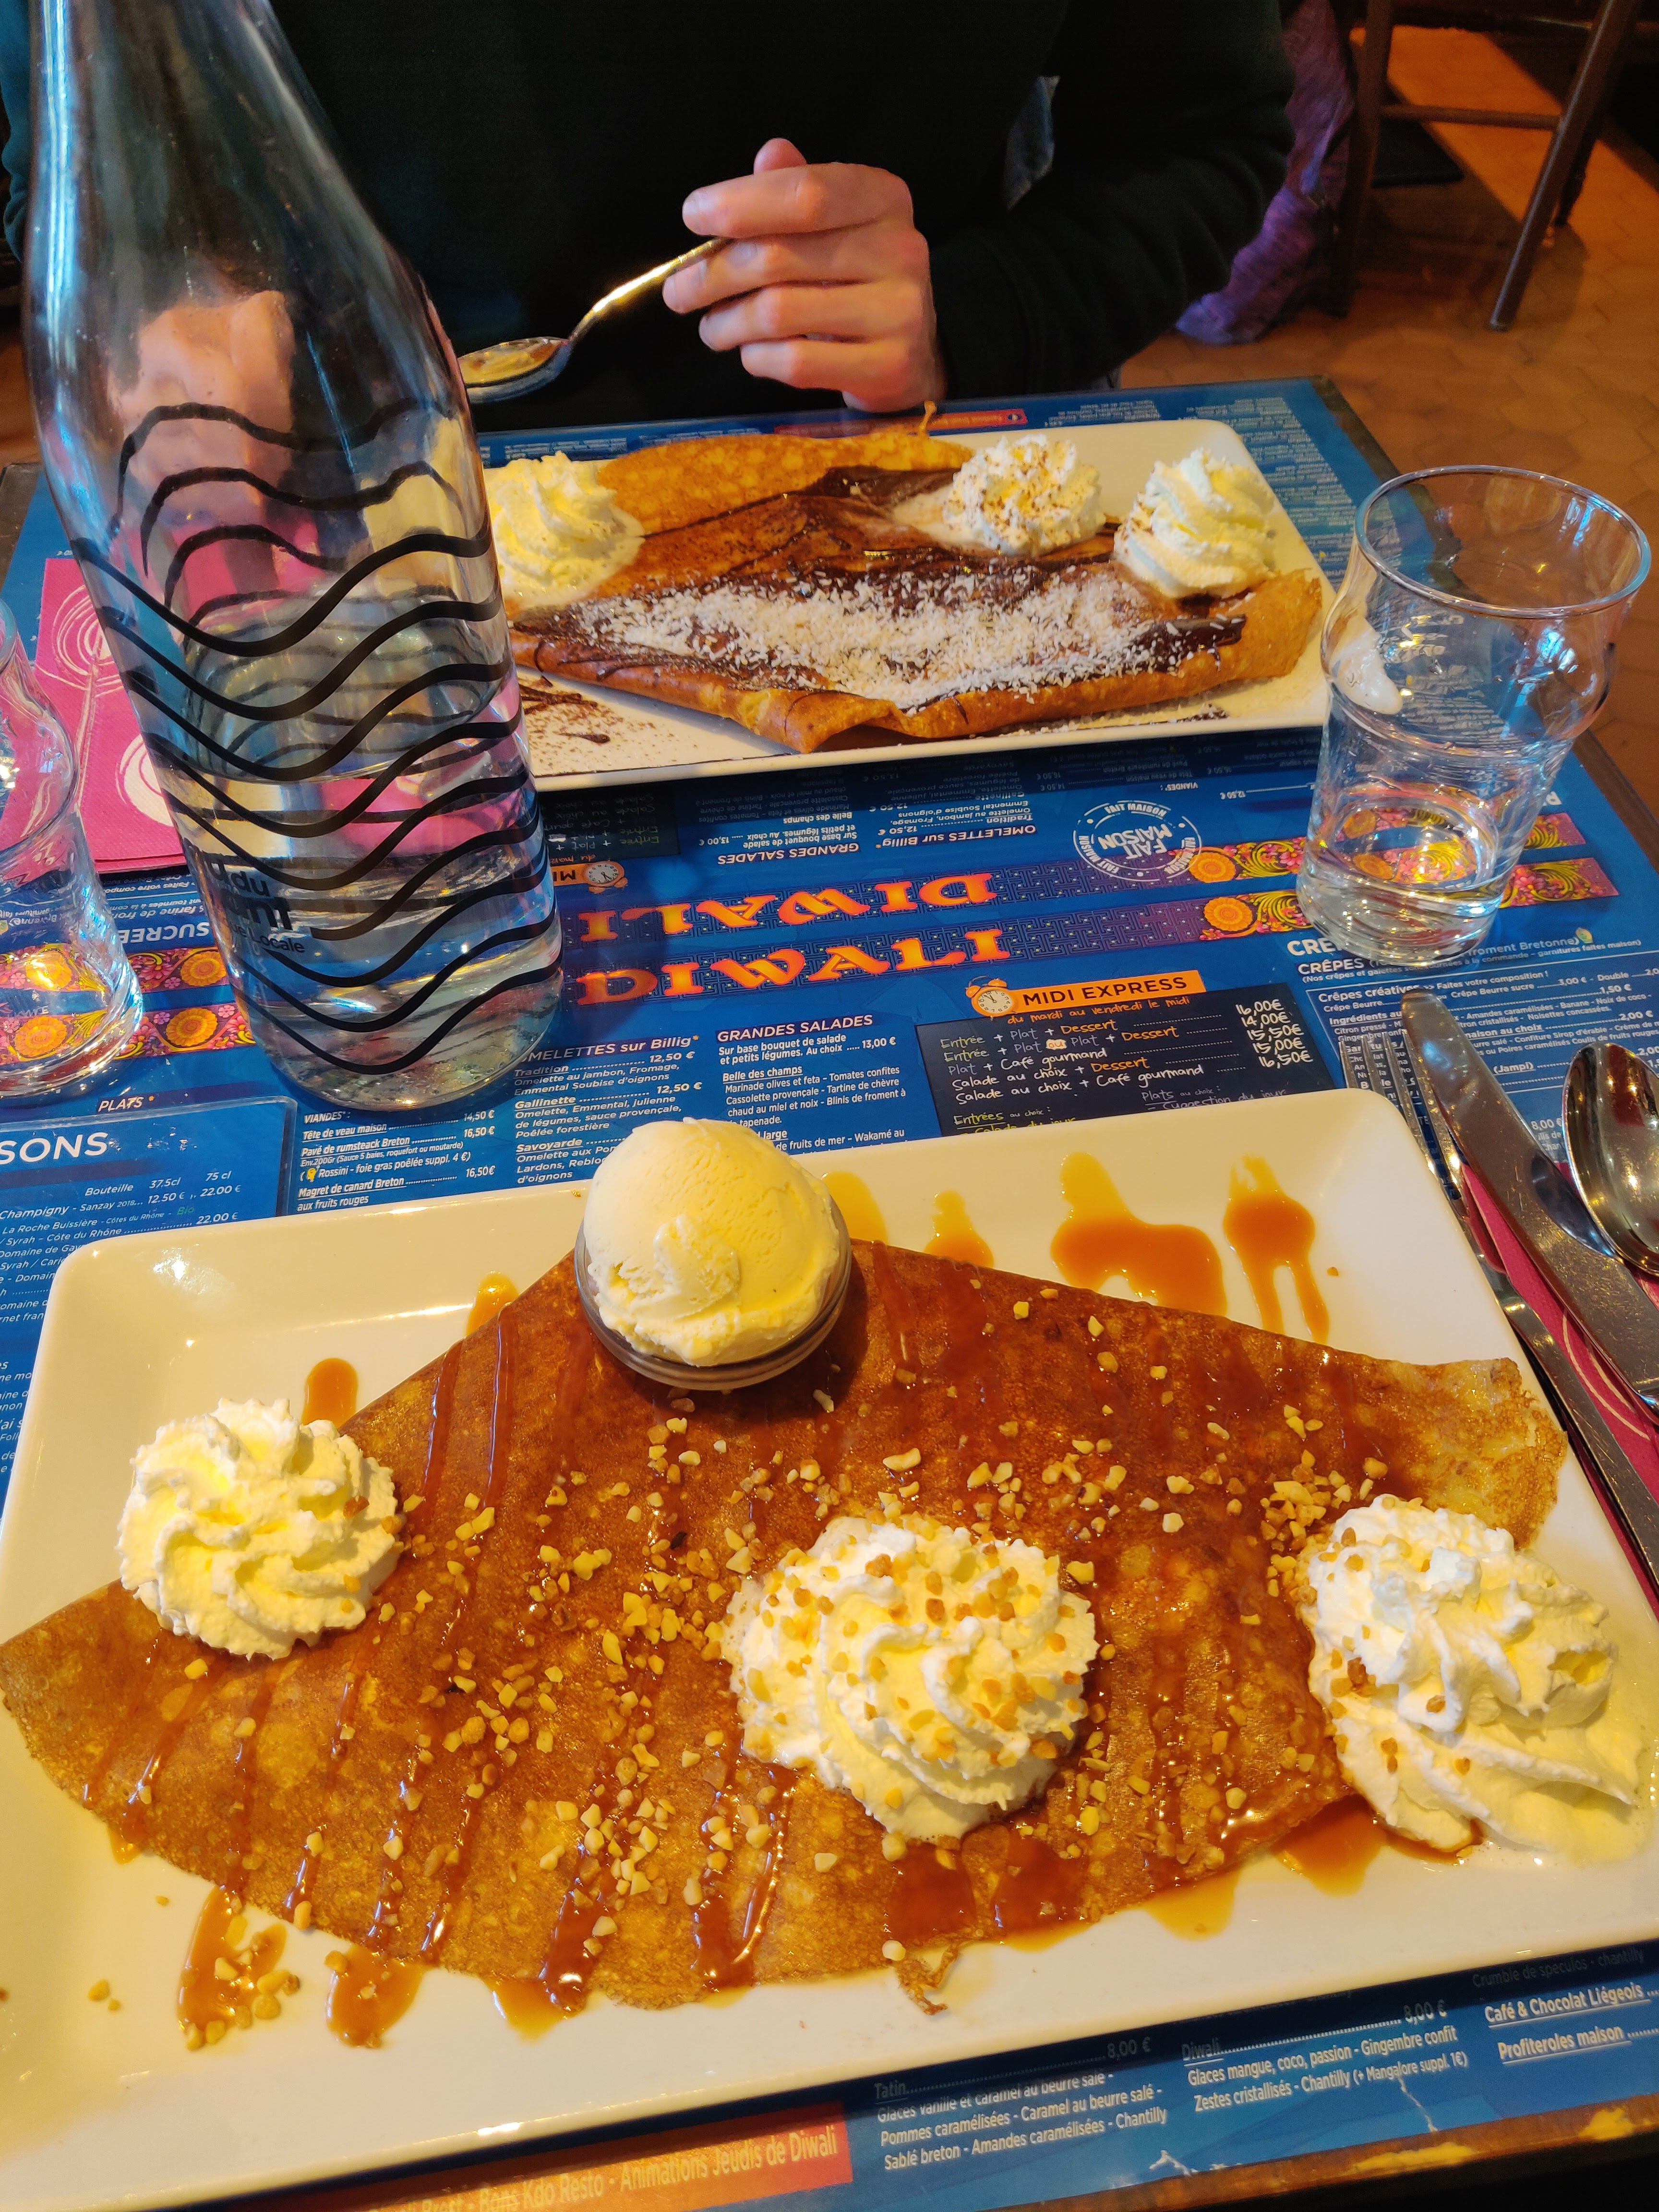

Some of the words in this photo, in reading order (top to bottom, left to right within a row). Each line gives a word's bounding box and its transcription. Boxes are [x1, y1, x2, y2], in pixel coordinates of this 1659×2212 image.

[815, 813, 830, 821] des
[831, 811, 852, 820] Belle
[1105, 803, 1125, 814] FAIT
[1127, 803, 1166, 817] MAISON
[782, 815, 814, 824] champs
[922, 833, 944, 842] sur
[948, 824, 1036, 842] OMELETTES
[1098, 824, 1172, 849] MAISON
[717, 849, 785, 865] SALADES
[789, 842, 859, 858] GRANDES
[1125, 838, 1166, 860] FAIT
[140, 910, 156, 918] de
[160, 906, 196, 915] farine
[579, 873, 996, 941] DIWALI
[1519, 937, 1579, 950] Bretonne)
[577, 929, 1010, 1005] DIWALI
[1298, 959, 1364, 974] CRÊPES
[1325, 972, 1354, 980] crêpes
[1436, 981, 1464, 989] Faites
[1489, 972, 1544, 984] composition
[1597, 971, 1629, 981] Double
[1023, 989, 1074, 1006] MIDI
[1082, 977, 1187, 999] EXPRESS
[1600, 986, 1622, 994] 1,50
[1623, 983, 1632, 991] €
[1007, 1014, 1024, 1024] du
[1029, 1010, 1063, 1022] mardi
[1091, 1001, 1142, 1015] vendredi
[1147, 999, 1160, 1009] le
[1165, 996, 1190, 1008] midi
[1236, 999, 1284, 1015] 16,00€
[1323, 1004, 1351, 1012] Crêpe
[1352, 1000, 1383, 1009] Beurre
[1241, 1012, 1290, 1028] 14,00€
[1620, 1011, 1644, 1021] 2,00
[1645, 1010, 1653, 1018] €
[717, 1023, 795, 1042] GRANDES
[799, 1014, 873, 1033] SALADES
[939, 1035, 986, 1049] Entrée
[1009, 1027, 1038, 1040] Plat
[1059, 1019, 1118, 1034] Dessert
[1247, 1024, 1303, 1041] 15,50€
[718, 1046, 734, 1056] Sur
[736, 1044, 759, 1054] base
[760, 1038, 800, 1051] bouquet
[802, 1036, 814, 1046] de
[816, 1033, 847, 1045] salade
[861, 1037, 887, 1049] 13,00
[889, 1036, 896, 1046] €
[1253, 1038, 1306, 1055] 15,00€
[519, 1043, 616, 1062] MELETTES
[619, 1042, 646, 1052] sur
[649, 1052, 682, 1063] 12,50
[685, 1050, 695, 1059] €
[720, 1055, 730, 1065] et
[731, 1052, 759, 1065] petits
[805, 1046, 818, 1056] Au
[819, 1043, 842, 1054] choix
[1259, 1050, 1313, 1069] 16,50€
[947, 1062, 977, 1076] Plat
[1000, 1055, 1034, 1070] Café
[1041, 1048, 1107, 1069] gourmand
[514, 1065, 569, 1077] Tradition
[514, 1075, 565, 1086] Omelette
[581, 1069, 625, 1080] jambon,
[629, 1063, 680, 1074] Fromage,
[723, 1070, 745, 1082] Belle
[748, 1070, 765, 1079] des
[767, 1066, 802, 1078] champs
[951, 1074, 999, 1091] Salade
[1006, 1073, 1026, 1081] au
[1033, 1066, 1068, 1080] choix
[1090, 1056, 1150, 1072] Dessert
[514, 1082, 569, 1095] Emmental
[571, 1079, 614, 1089] Soubise
[617, 1073, 670, 1084] d'oignons
[724, 1081, 764, 1094] Marinade
[766, 1079, 791, 1089] olives
[792, 1076, 802, 1086] et
[803, 1075, 820, 1084] feta
[828, 1070, 865, 1082] Tomates
[866, 1066, 900, 1077] confites
[97, 1096, 144, 1112] PLATS
[514, 1096, 576, 1109] Gallinette
[464, 1110, 486, 1122] 14,50
[487, 1109, 495, 1119] €
[303, 1130, 321, 1140] Tête
[322, 1128, 334, 1138] de
[335, 1127, 356, 1136] veau
[356, 1123, 387, 1133] maison
[464, 1126, 487, 1139] 16,50
[487, 1125, 495, 1135] €
[301, 1144, 323, 1157] Pavé
[323, 1144, 335, 1154] de
[336, 1138, 381, 1152] rumsteack
[382, 1136, 410, 1148] Breton
[515, 1139, 583, 1153] Savoyarde
[205, 1171, 219, 1181] 75
[221, 1170, 232, 1179] cl
[466, 1165, 496, 1178] 16,50€
[84, 1183, 133, 1196] Bouteille
[199, 1185, 232, 1197] 22.00
[234, 1184, 240, 1192] €
[298, 1185, 330, 1198] Magret
[330, 1183, 342, 1194] de
[343, 1179, 374, 1192] canard
[374, 1177, 405, 1189] Breton
[147, 1192, 177, 1204] 12.50
[178, 1191, 185, 1200] €
[296, 1202, 313, 1212] aux
[314, 1197, 338, 1209] fruits
[338, 1195, 369, 1206] rouges
[0, 1205, 70, 1220] Champigny
[79, 1202, 115, 1212] Sanzay
[1, 1226, 15, 1234] La
[17, 1223, 50, 1233] Roche
[51, 1219, 97, 1229] Buissière
[140, 1209, 165, 1220] Rhône
[1485, 2003, 1515, 2022] Café
[1517, 2000, 1528, 2018] &
[1529, 1992, 1587, 2015] Chocolat
[1587, 1982, 1643, 2006] Liégeois
[1498, 2033, 1575, 2059] Profiteroles
[1576, 2026, 1624, 2045] maison
[1188, 2068, 1226, 2086] Glaces
[1226, 2059, 1276, 2080] mangue,
[1277, 2054, 1308, 2071] coco,
[1309, 2045, 1352, 2068] passion
[1360, 2033, 1423, 2056] Gingembre
[1424, 2026, 1458, 2045] confit
[880, 2126, 932, 2147] Pommes
[934, 2111, 1010, 2137] caramélisées
[1021, 2099, 1070, 2121] Caramel
[1072, 2099, 1087, 2113] au
[1089, 2092, 1129, 2110] beurre
[1130, 2085, 1154, 2102] salé
[791, 2126, 838, 2161] Diwali
[884, 2149, 918, 2170] Sablé
[920, 2145, 961, 2164] breton
[971, 2132, 1027, 2155] Amandes
[1029, 2118, 1106, 2144] caramélisées
[1115, 2107, 1167, 2129] Chantilly
